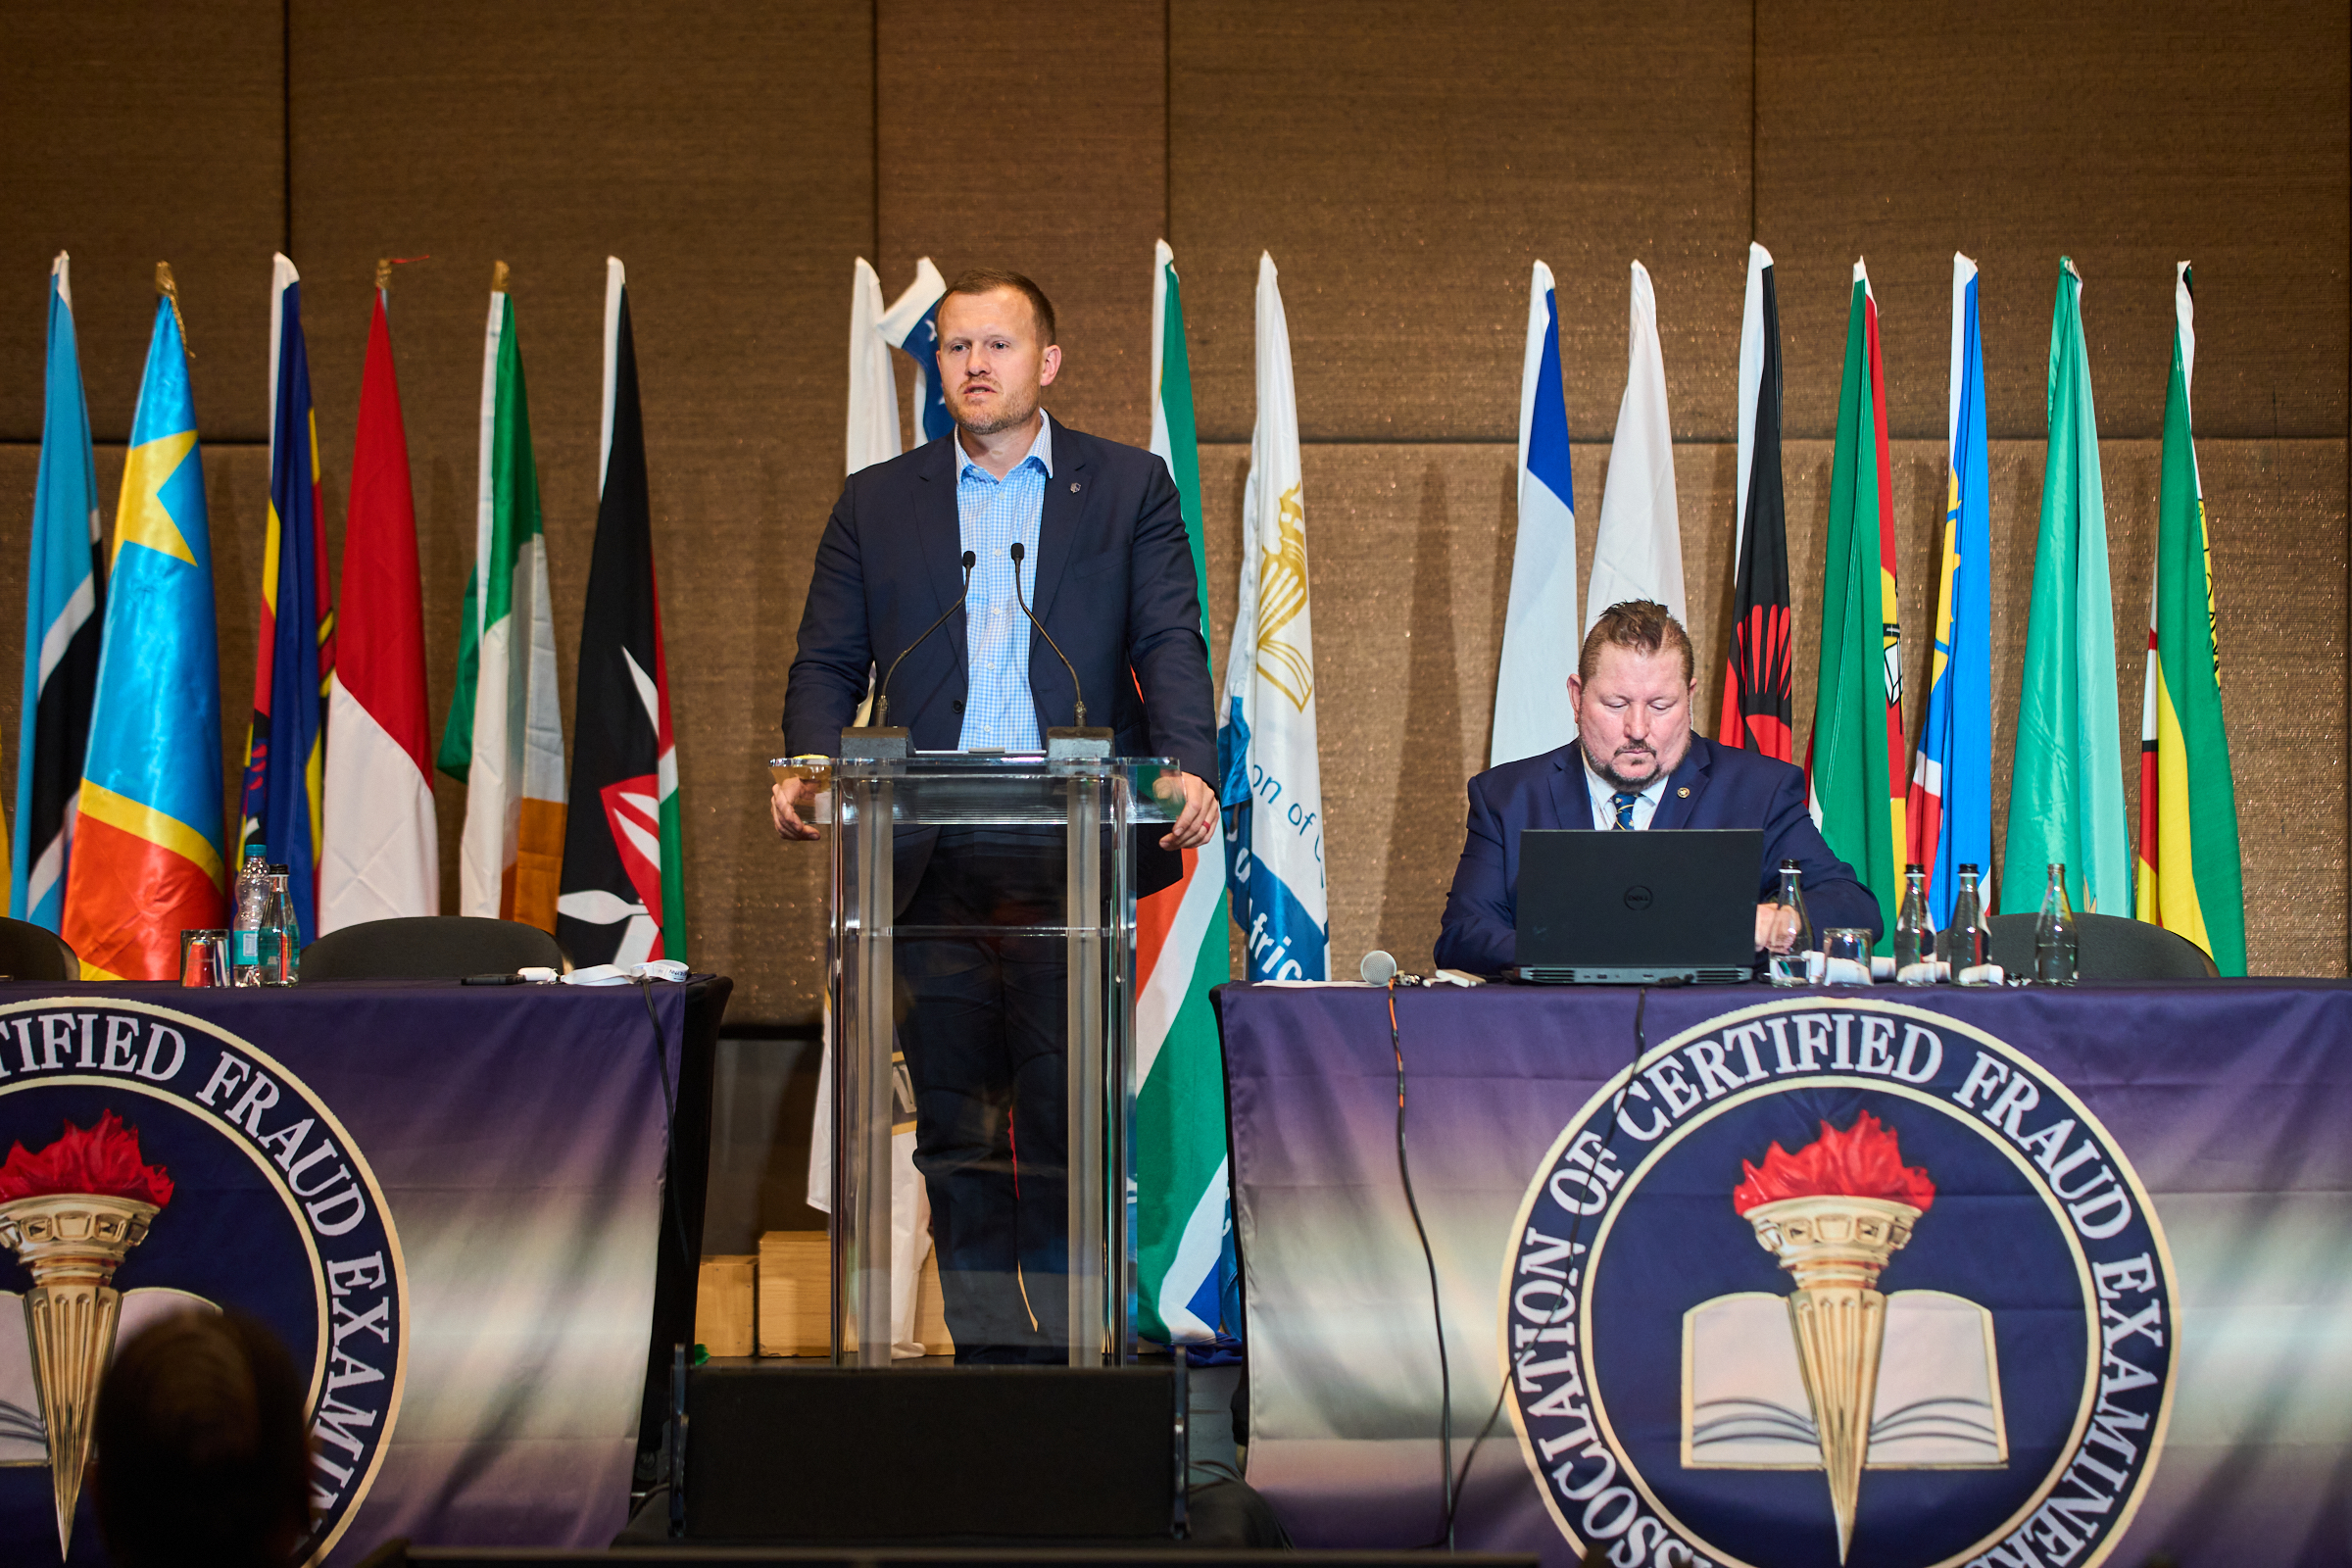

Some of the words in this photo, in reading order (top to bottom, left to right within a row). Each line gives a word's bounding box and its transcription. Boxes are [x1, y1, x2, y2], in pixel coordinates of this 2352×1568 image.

[1288, 803, 1317, 836] of
[1249, 898, 1314, 981] fric
[0, 1012, 186, 1081] IFIED
[195, 1051, 367, 1237] FRAUD
[1613, 1012, 1943, 1142] CERTIFIED
[1952, 1051, 2132, 1240] FRAUD
[1549, 1132, 1622, 1216] OF
[1514, 1228, 1713, 1568] SOCIATION
[1963, 1252, 2165, 1568] EXAMINER
